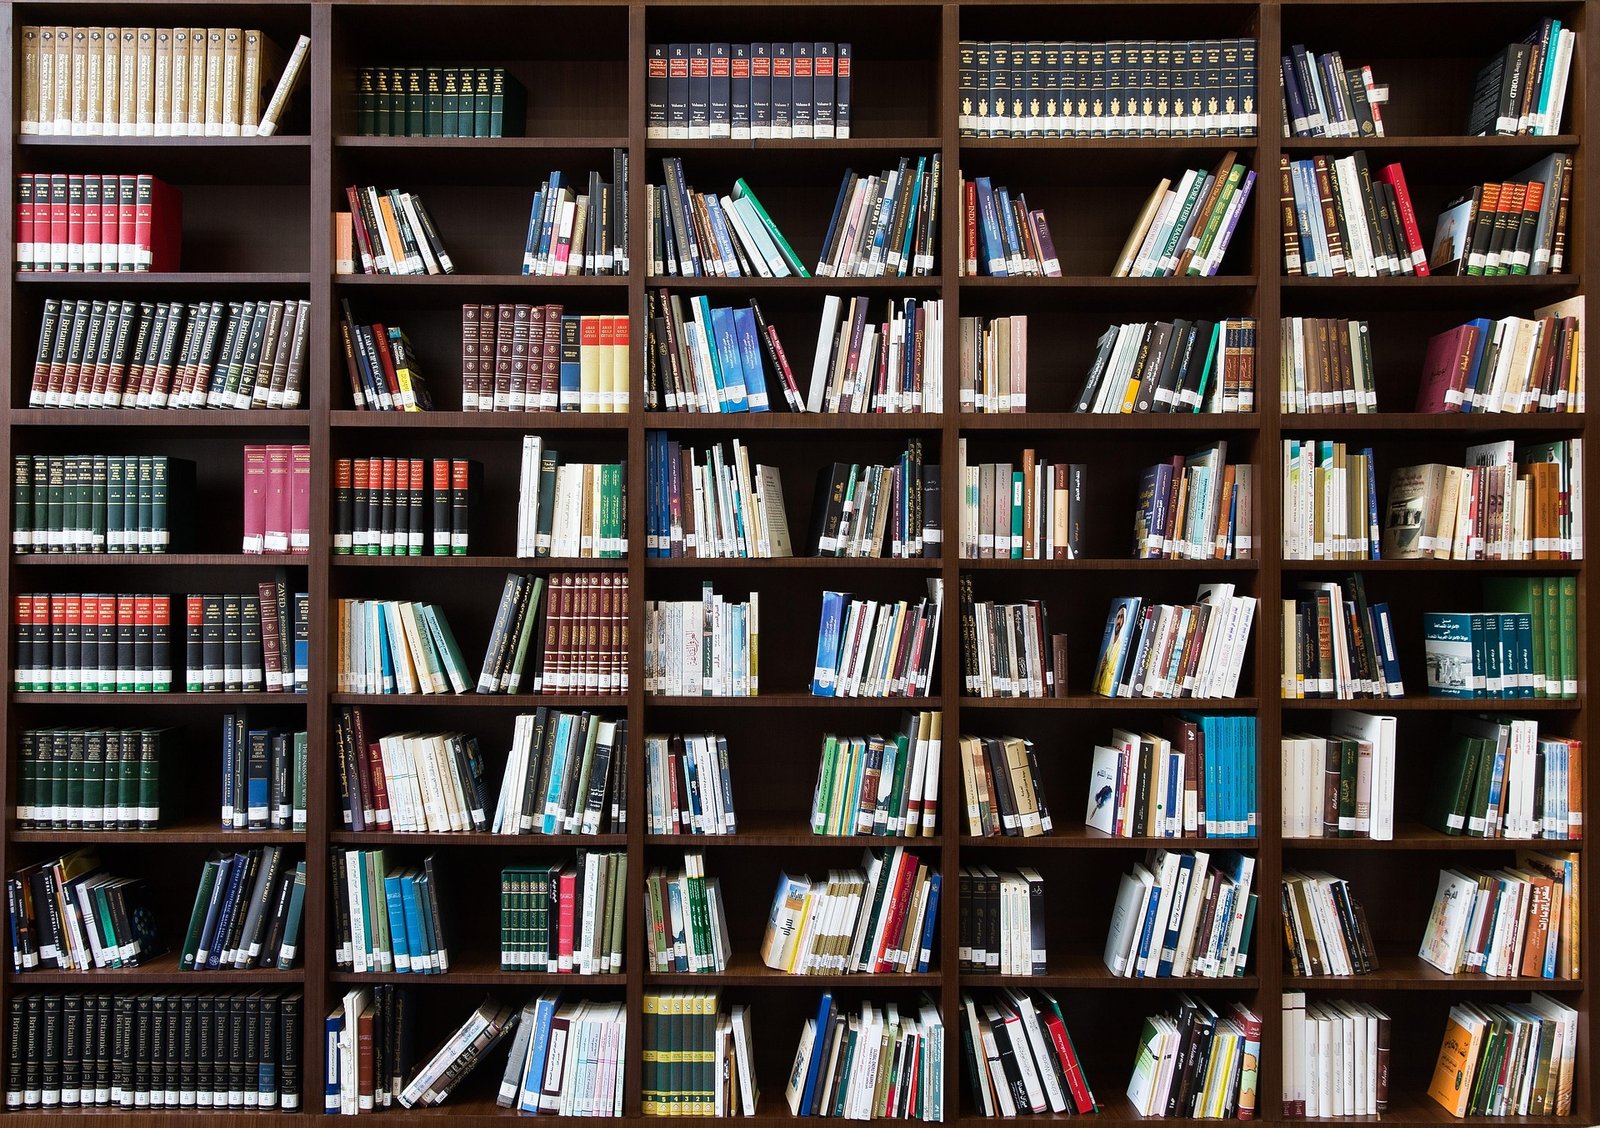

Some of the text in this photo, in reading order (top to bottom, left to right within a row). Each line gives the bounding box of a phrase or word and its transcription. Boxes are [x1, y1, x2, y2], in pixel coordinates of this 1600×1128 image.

[1510, 73, 1520, 98] WORLD
[1216, 170, 1228, 188] INDIA
[1360, 167, 1371, 193] زايد
[865, 197, 883, 251] DUBAI CITY
[1164, 176, 1204, 257] BEFORE THEIR DIASPORA
[40, 318, 54, 358] Britannica
[55, 318, 69, 358] Britannica
[70, 318, 84, 358] Britannica
[85, 318, 99, 358] Britannica
[100, 319, 114, 358] Britannica
[116, 319, 130, 358] Britannica
[134, 321, 148, 360] Britannica
[149, 321, 163, 360] Britannica
[164, 321, 178, 361] Britannica
[180, 321, 195, 361] Britannica
[190, 320, 204, 360] Britannica
[203, 320, 219, 360] Britannica
[221, 321, 236, 360] Britannica
[235, 320, 249, 360] Britannica
[250, 321, 262, 359] 1998
[280, 616, 289, 653] photographic
[236, 719, 244, 745] زايد
[268, 862, 276, 880] ARAB
[262, 881, 271, 903] WORLD
[1530, 887, 1539, 914] موسوعة
[49, 905, 58, 936] PICTORIAL
[11, 1018, 20, 1059] Britannica
[27, 1017, 36, 1057] Britannica
[47, 1016, 55, 1057] Britannica
[67, 1015, 75, 1056] Britannica
[85, 1015, 94, 1055] Britannica
[99, 1015, 108, 1055] Britannica
[140, 1016, 148, 1057] Britannica
[155, 1016, 163, 1057] Britannica
[183, 1016, 192, 1057] Britannica
[200, 1016, 208, 1057] Britannica
[216, 1017, 224, 1057] Britannica
[231, 1017, 239, 1057] Britannica
[247, 1017, 256, 1058] Britannica
[264, 1017, 272, 1058] Britannica
[285, 1019, 293, 1060] Britannica
